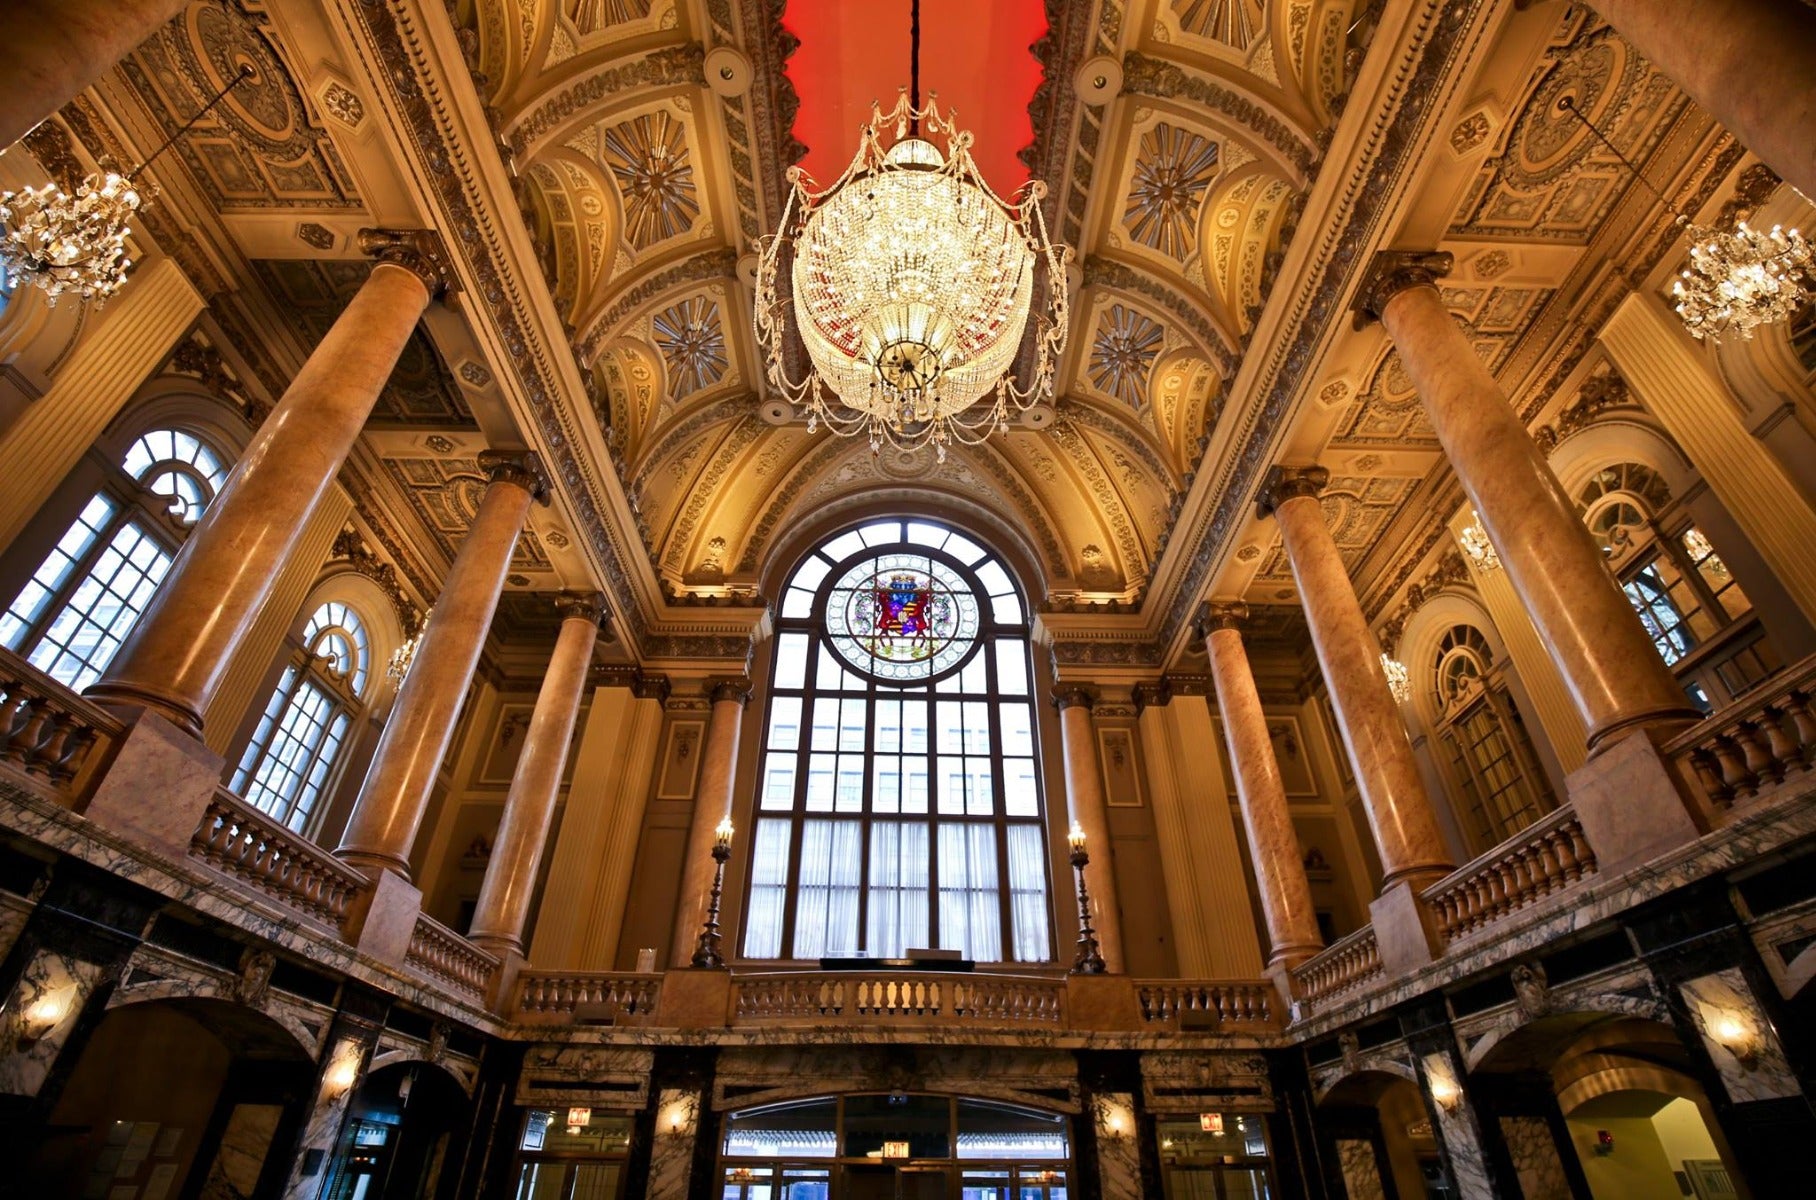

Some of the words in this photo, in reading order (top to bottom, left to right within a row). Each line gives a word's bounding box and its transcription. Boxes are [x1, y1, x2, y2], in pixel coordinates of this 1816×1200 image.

[568, 1108, 589, 1124] EXIT
[1202, 1114, 1221, 1129] EXIT
[887, 1142, 906, 1157] EXIT
